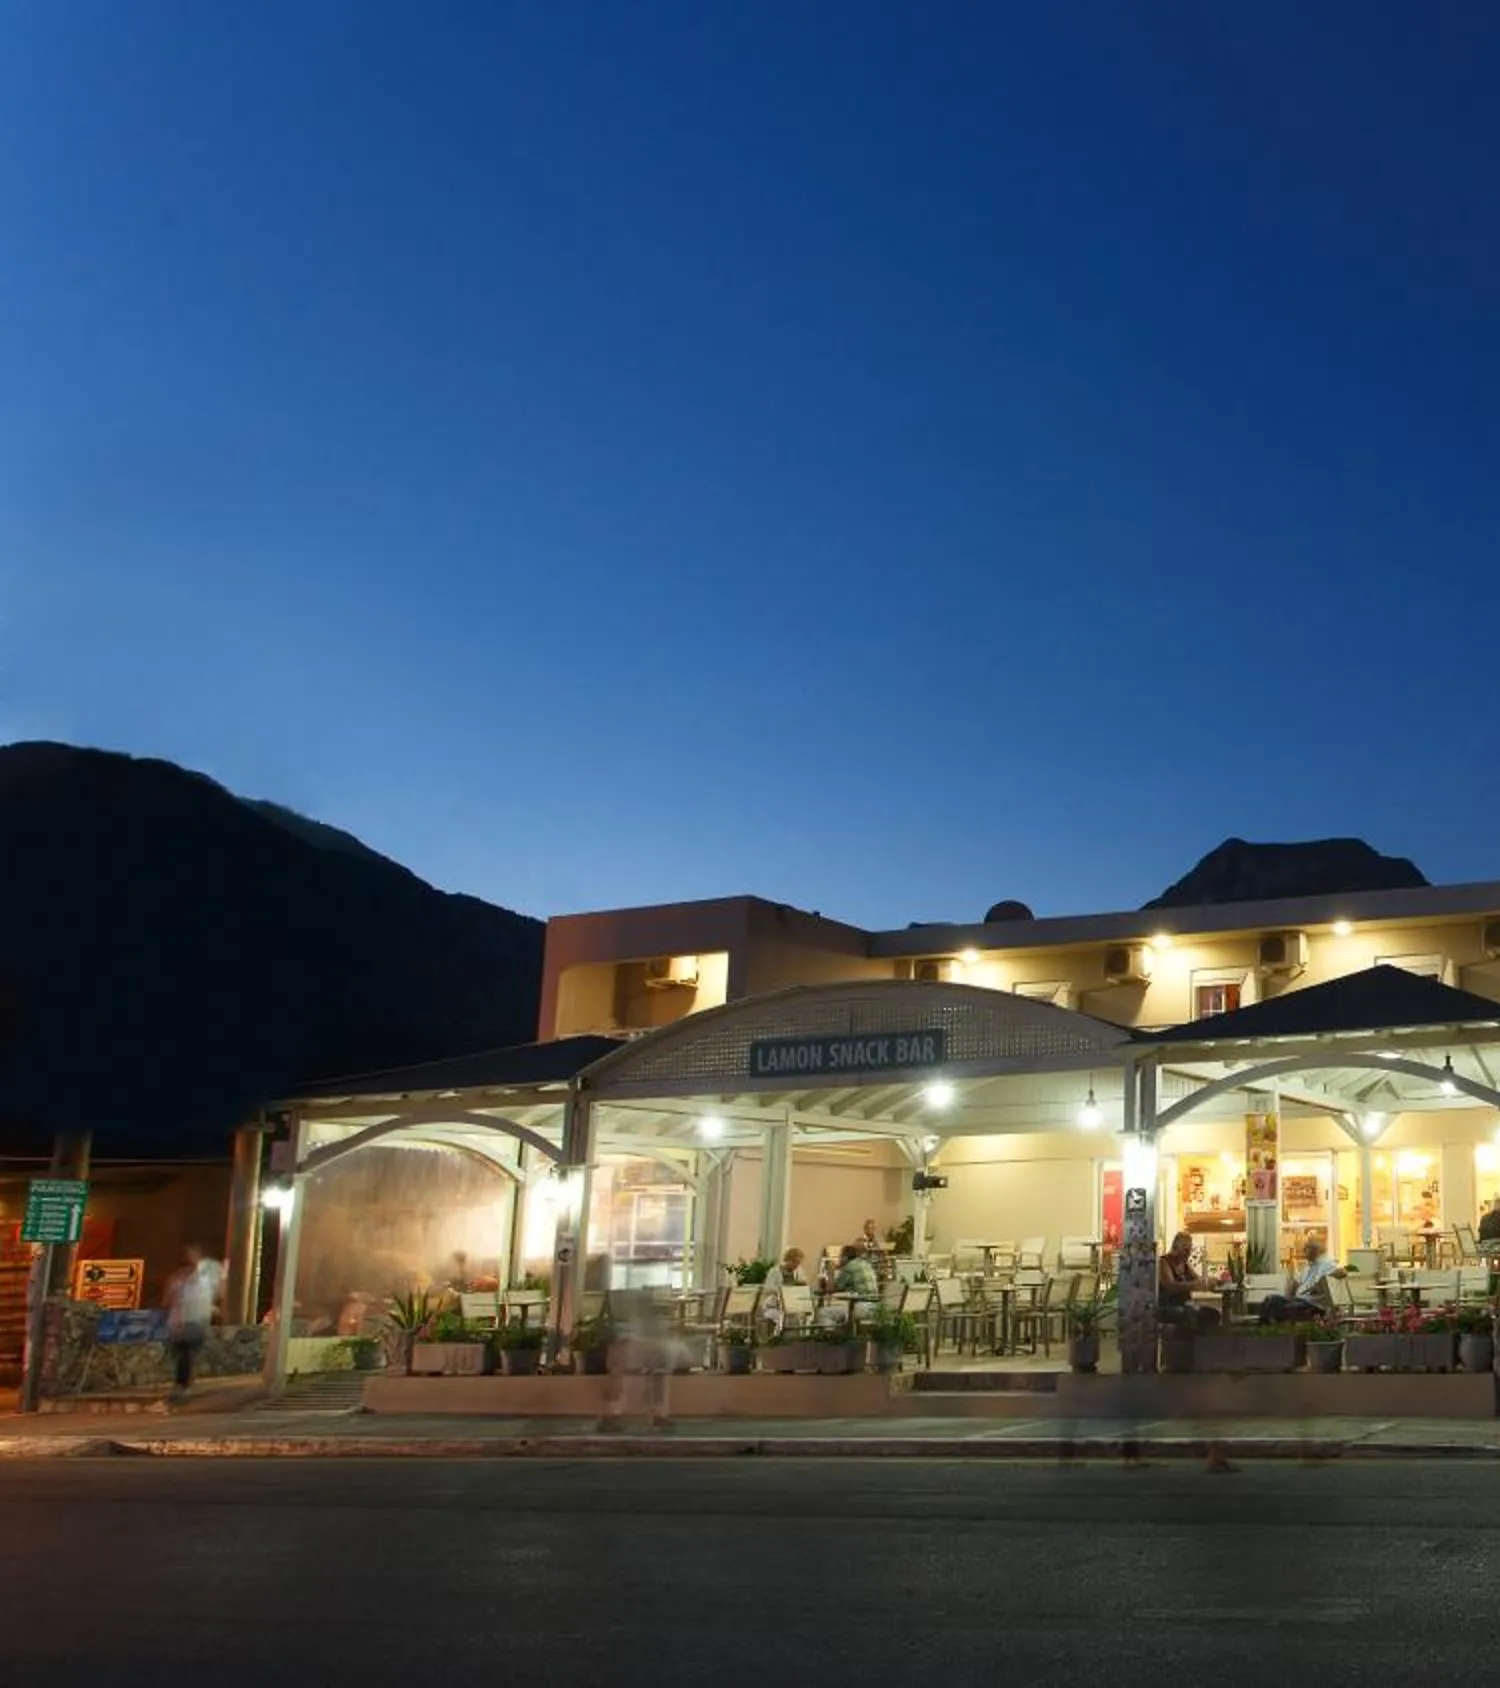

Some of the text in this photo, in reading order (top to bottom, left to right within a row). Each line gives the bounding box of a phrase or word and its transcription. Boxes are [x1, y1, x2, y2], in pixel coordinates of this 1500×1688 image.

[757, 1036, 935, 1072] LAMON SNACK BAR
